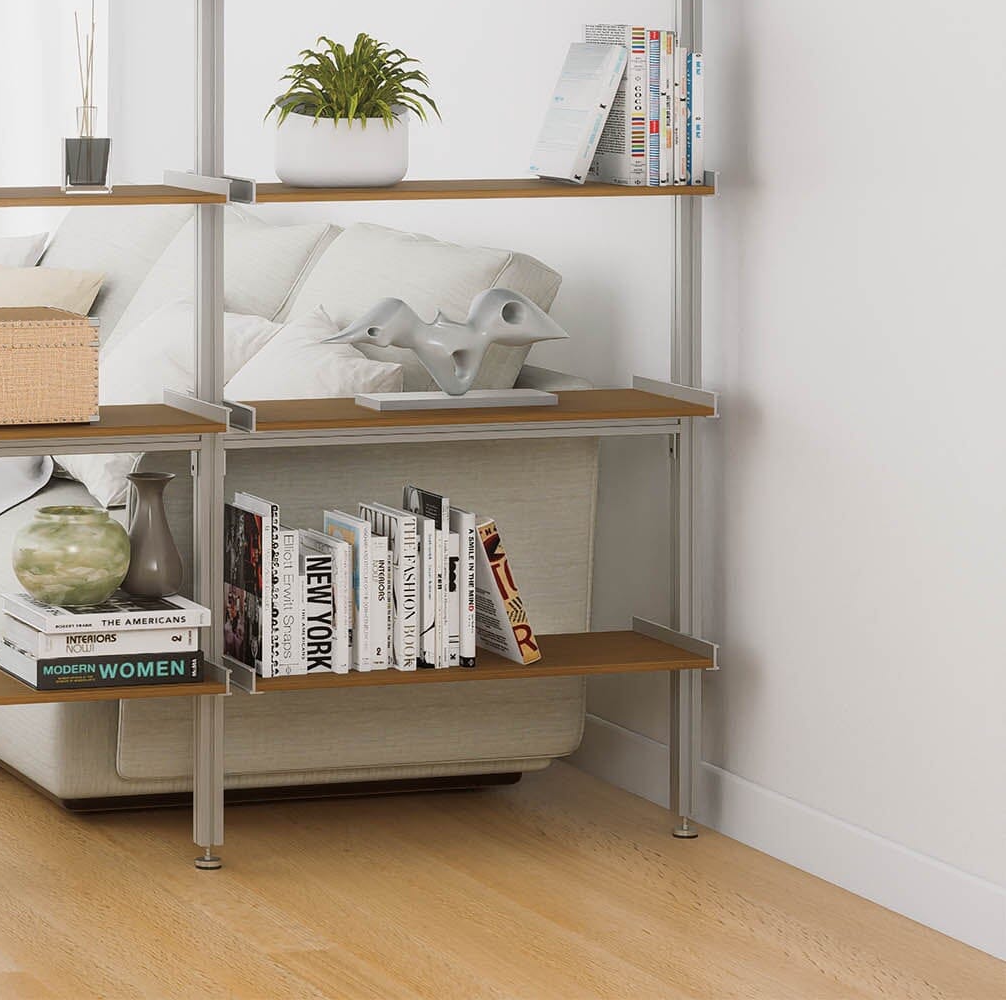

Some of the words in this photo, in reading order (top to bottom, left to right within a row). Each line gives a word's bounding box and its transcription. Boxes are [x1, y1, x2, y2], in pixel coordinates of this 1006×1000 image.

[283, 534, 294, 570] Elliott
[403, 518, 416, 551] THE
[306, 556, 332, 605] NEW
[468, 563, 475, 573] IN
[283, 574, 294, 610] Erwitt
[403, 555, 416, 620] FASHION
[66, 634, 117, 644] INTERIORS
[101, 618, 121, 627] THE
[125, 615, 187, 625] AMERICANS
[283, 613, 294, 659] Snaps
[306, 610, 332, 671] YORK
[403, 624, 416, 668] BOOK
[43, 663, 96, 676] MODERN
[98, 660, 186, 679] WOMEN
